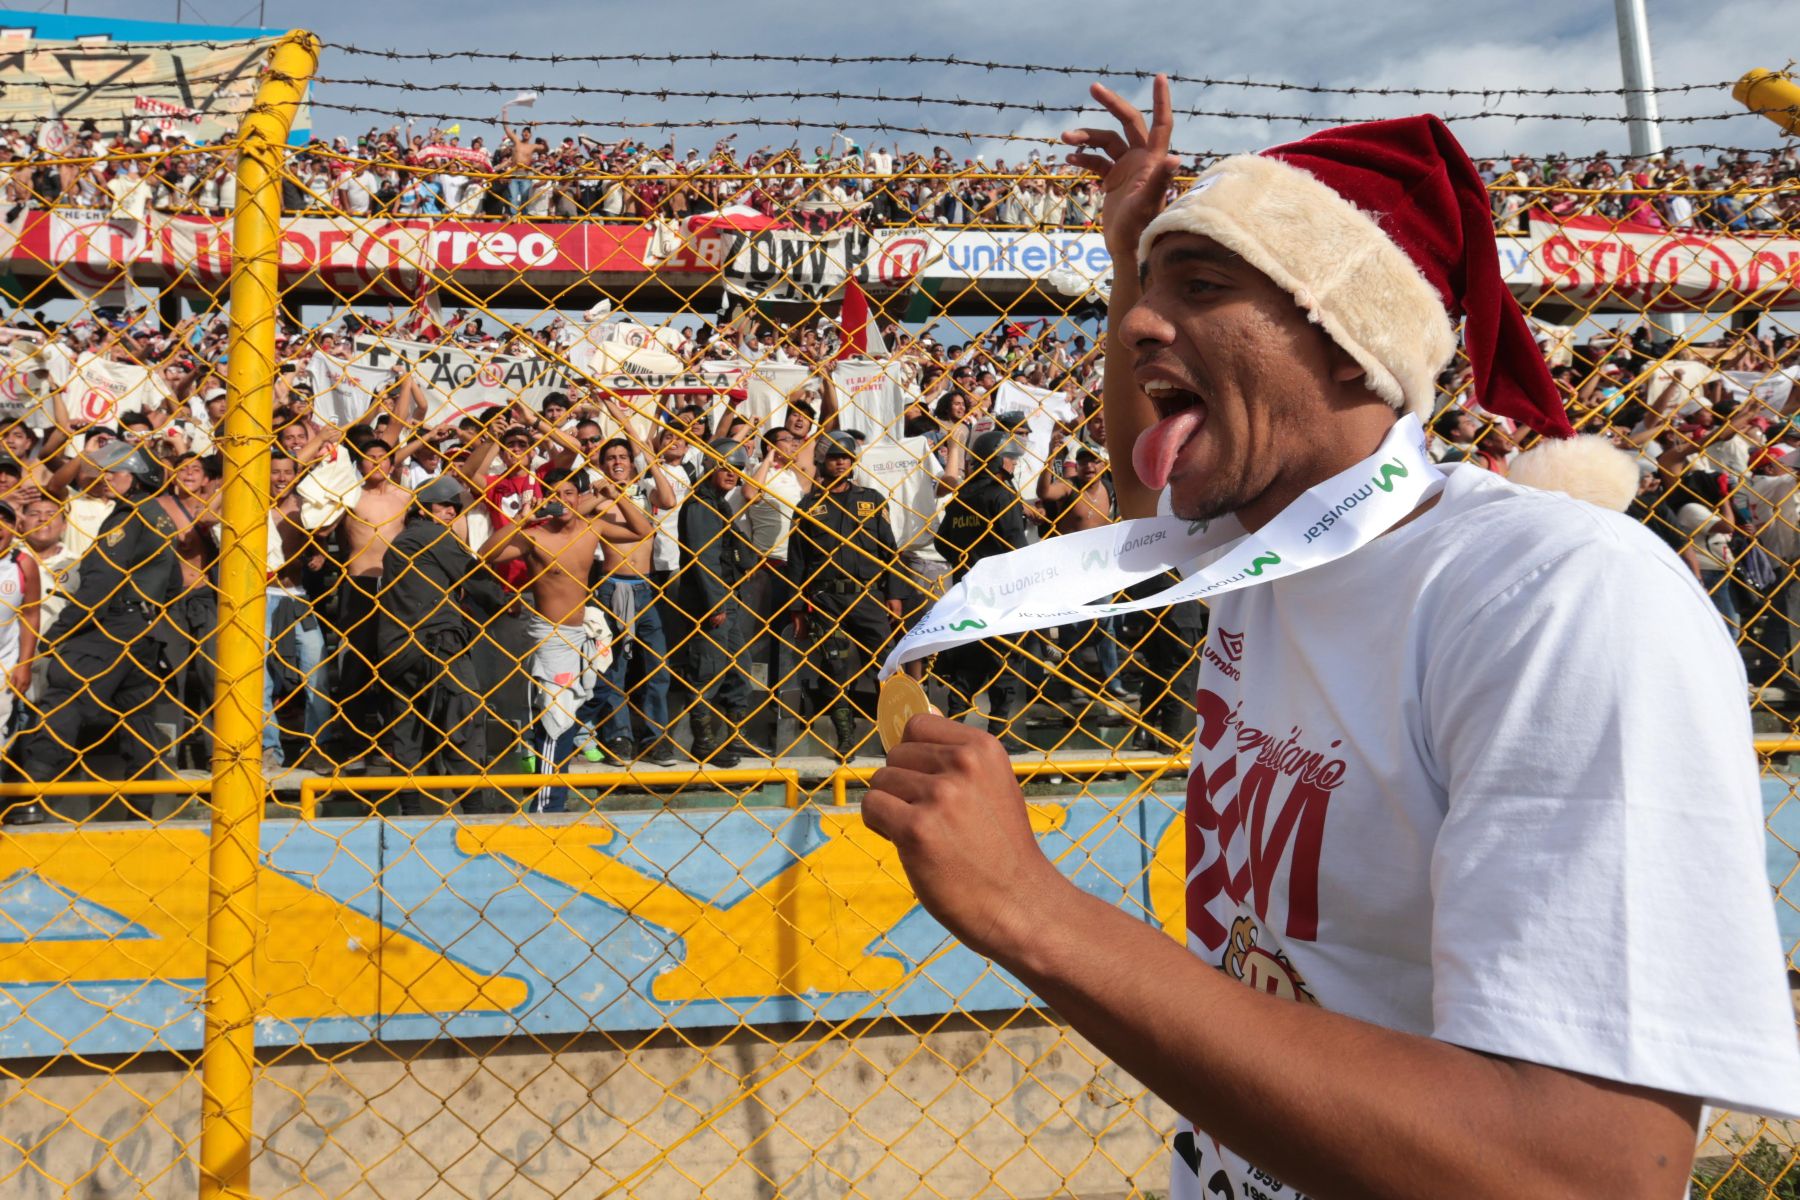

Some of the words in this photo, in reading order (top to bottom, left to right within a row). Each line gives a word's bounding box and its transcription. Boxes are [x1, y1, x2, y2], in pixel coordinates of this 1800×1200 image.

[613, 373, 730, 389] CAUTELA
[1303, 484, 1374, 544] movistar
[1204, 646, 1241, 682] umbro
